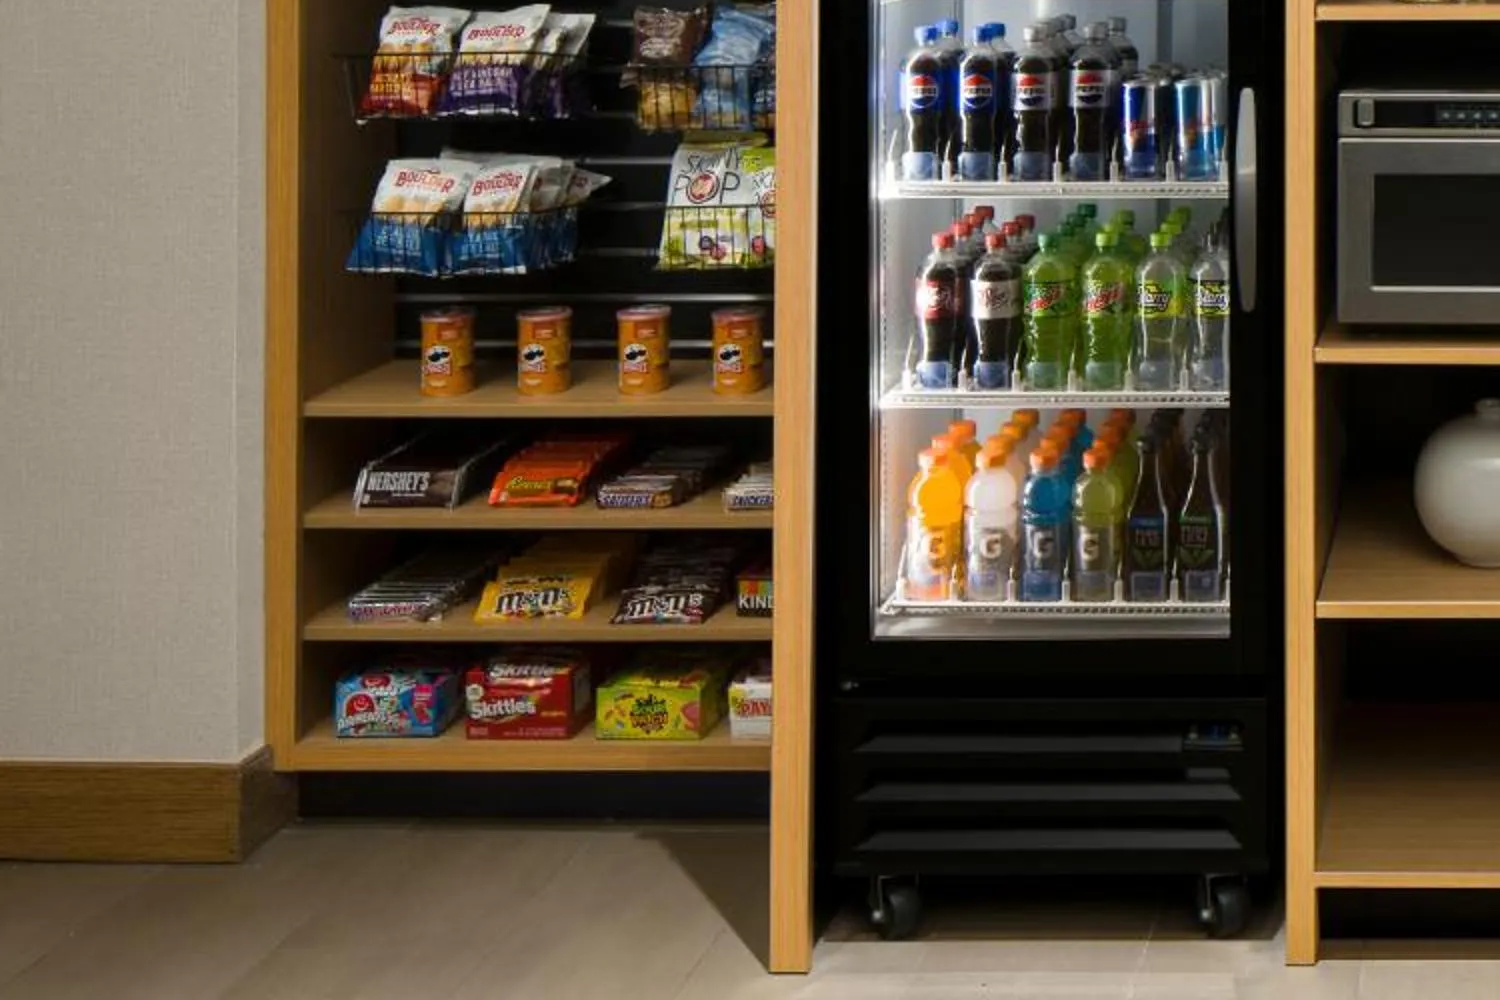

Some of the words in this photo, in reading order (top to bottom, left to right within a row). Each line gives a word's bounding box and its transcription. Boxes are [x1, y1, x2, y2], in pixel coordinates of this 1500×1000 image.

[395, 169, 455, 193] BOULDER
[472, 171, 523, 196] BOULDER
[366, 471, 430, 492] HERSHEY'S
[470, 698, 537, 720] Skittles
[741, 698, 773, 718] PAY
